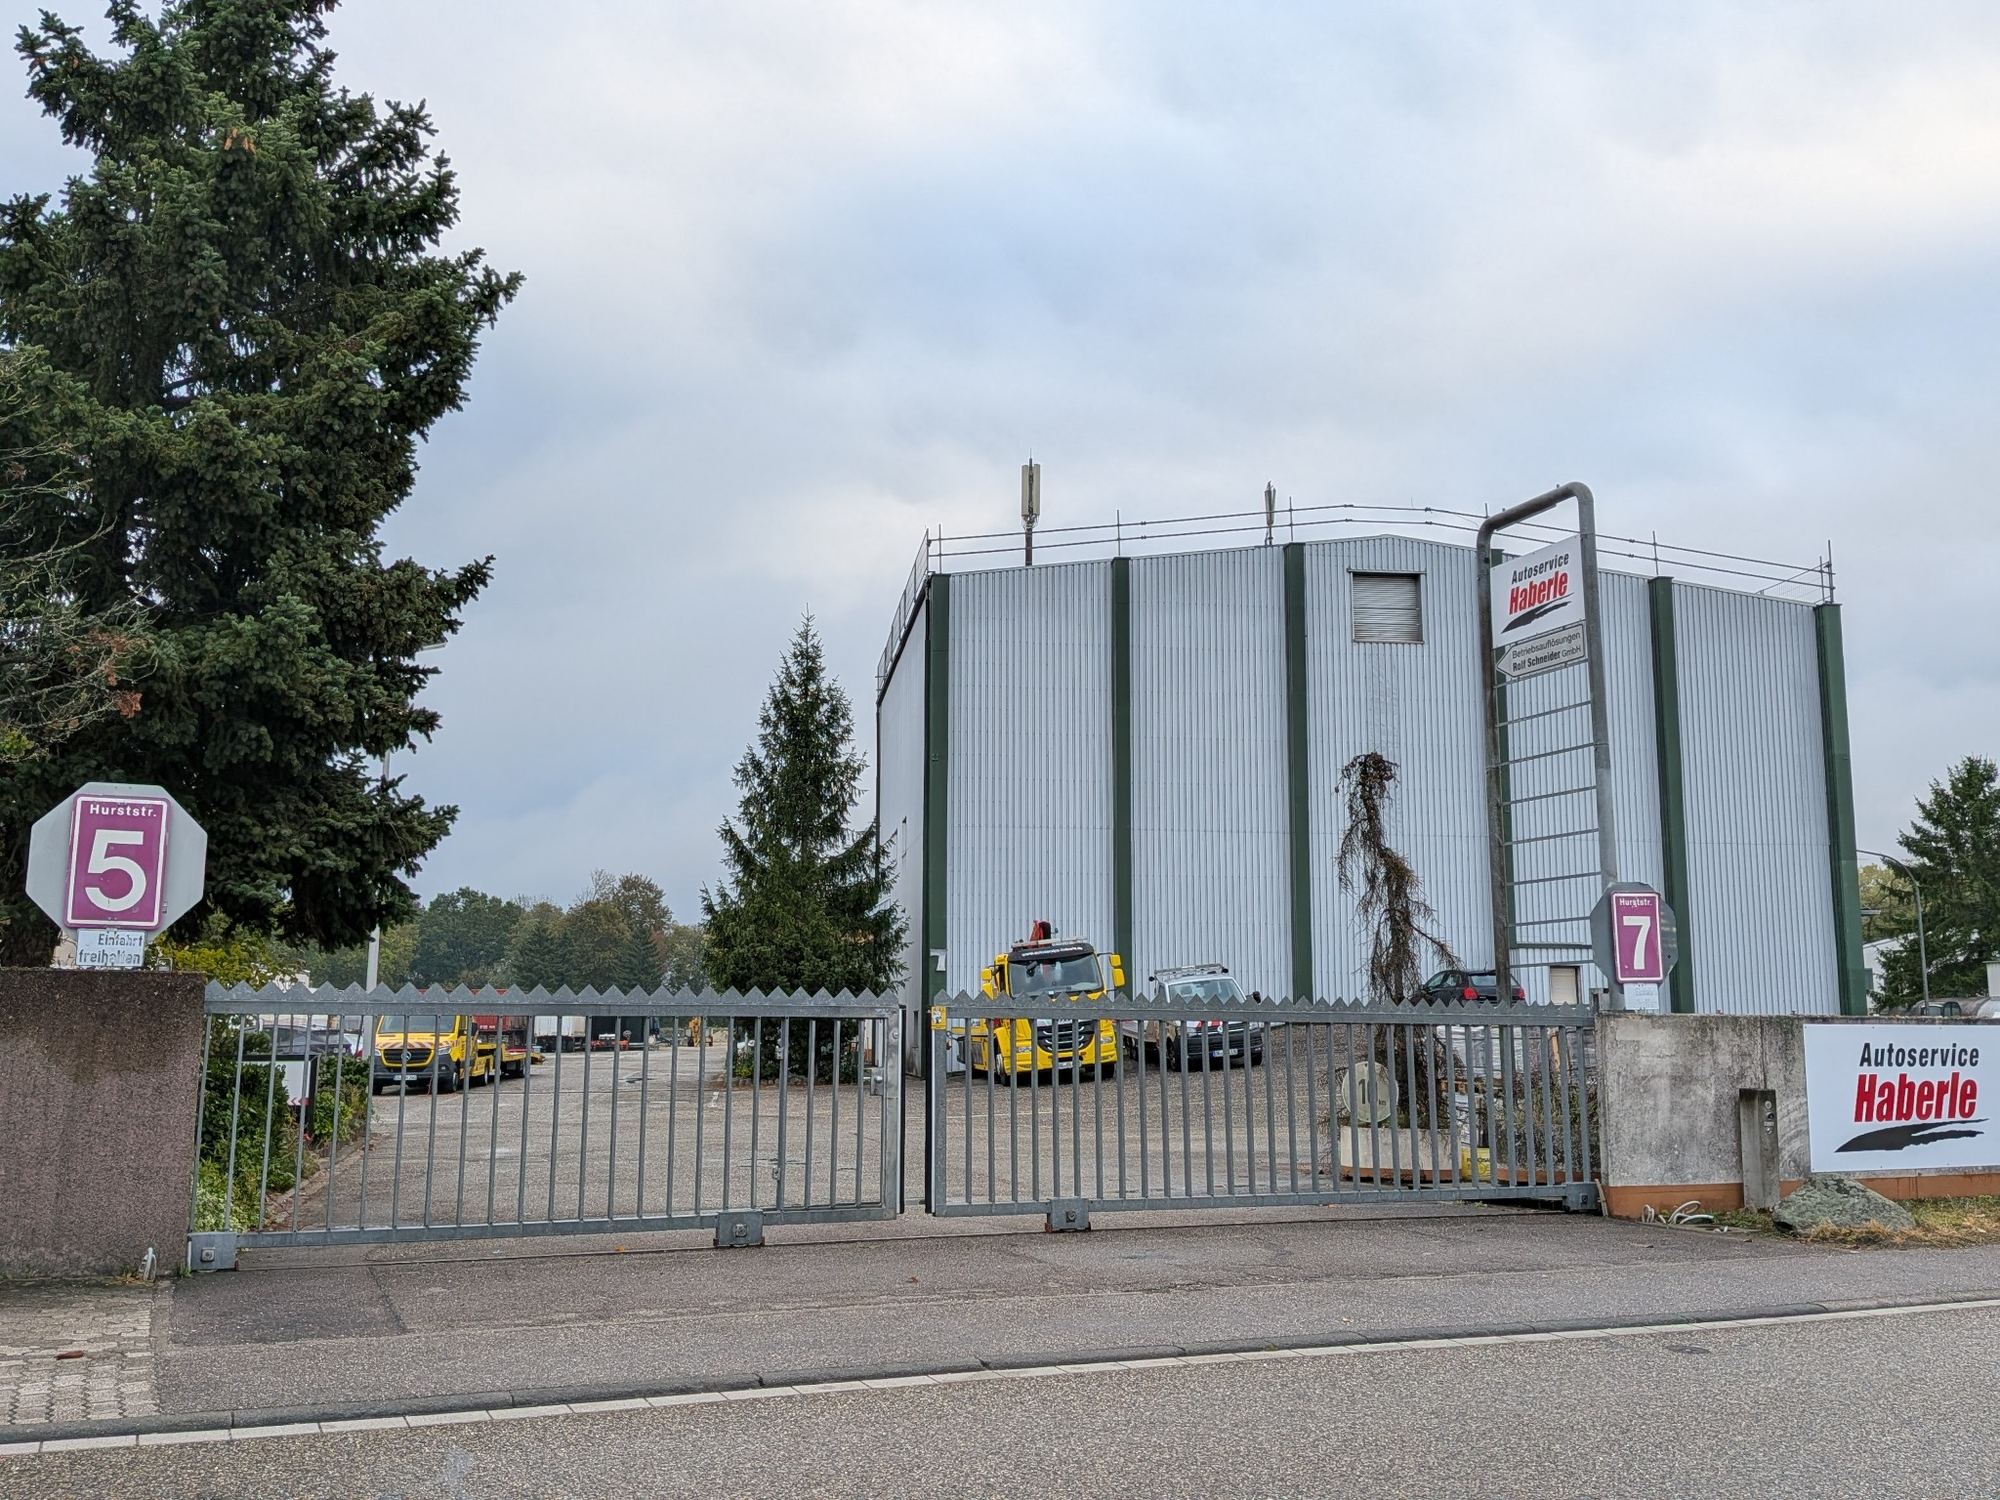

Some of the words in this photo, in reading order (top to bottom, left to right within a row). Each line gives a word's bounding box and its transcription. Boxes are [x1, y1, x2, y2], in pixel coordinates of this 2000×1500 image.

[1511, 553, 1569, 584] Autoservice
[1509, 571, 1569, 615] Haberle
[1513, 659, 1526, 672] Rolf
[1527, 650, 1561, 668] Schneider
[1562, 645, 1582, 657] GmbH
[90, 804, 157, 817] Hurststr.
[85, 829, 147, 912] 5
[98, 933, 143, 946] Einfahrt
[1622, 916, 1651, 970] 7
[79, 949, 141, 964] freihalten
[929, 949, 947, 971] 7
[1859, 1043, 1979, 1067] Autoservice
[1854, 1072, 1977, 1123] Haberle
